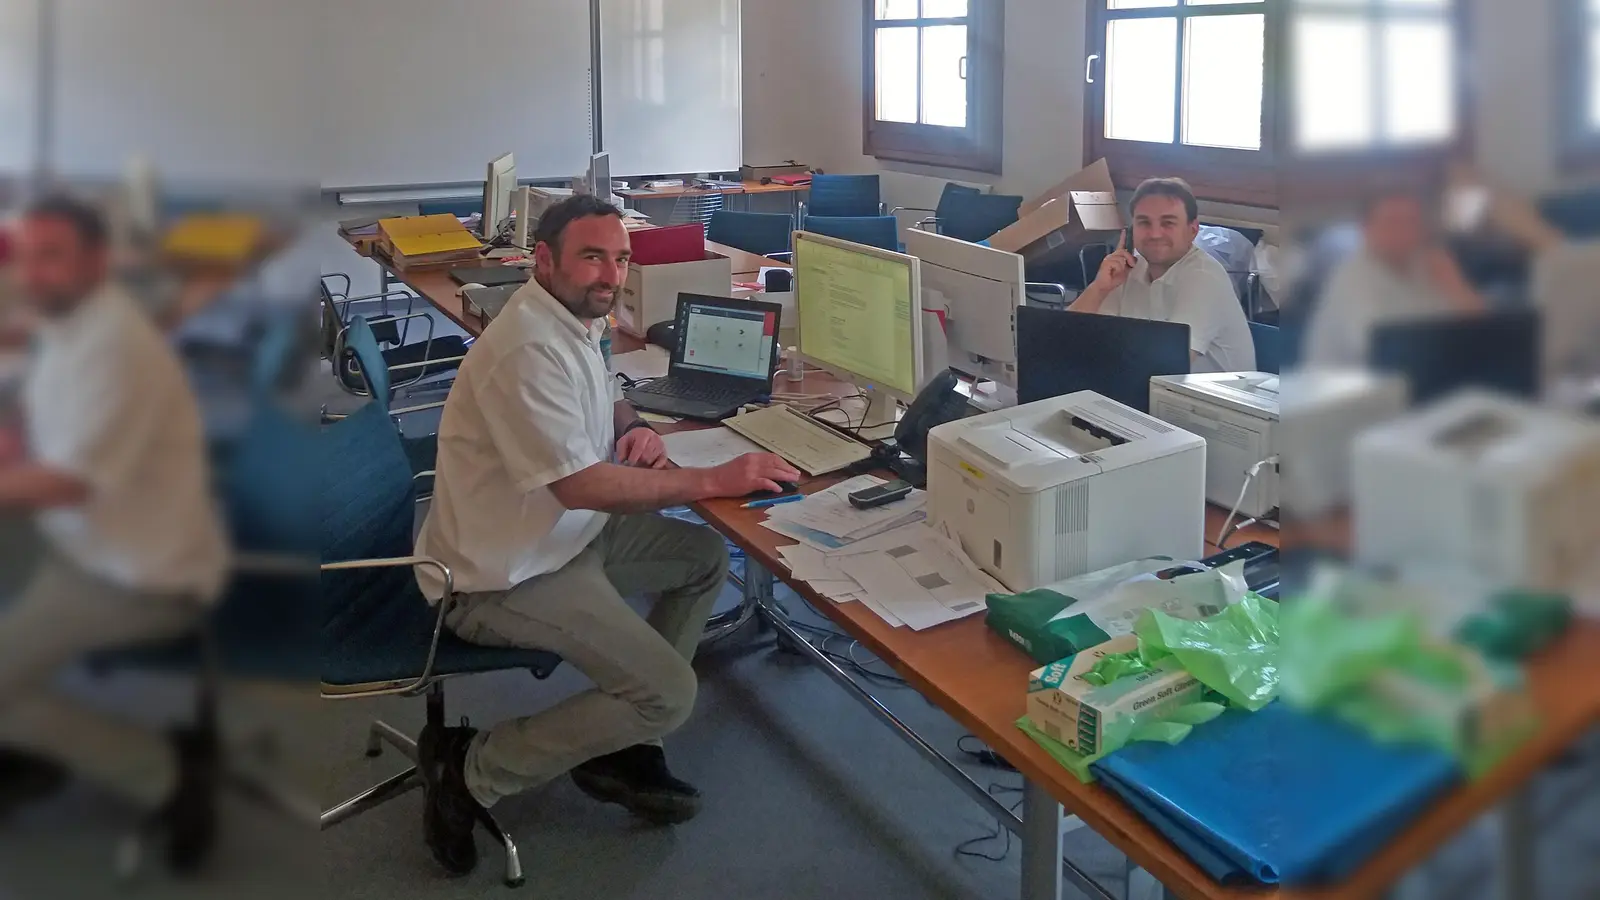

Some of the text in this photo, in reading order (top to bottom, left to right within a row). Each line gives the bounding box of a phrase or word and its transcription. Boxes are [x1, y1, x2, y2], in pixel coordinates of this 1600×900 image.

[1044, 663, 1067, 684] Soft
[1133, 696, 1156, 711] Green
[1157, 687, 1173, 700] Soft
